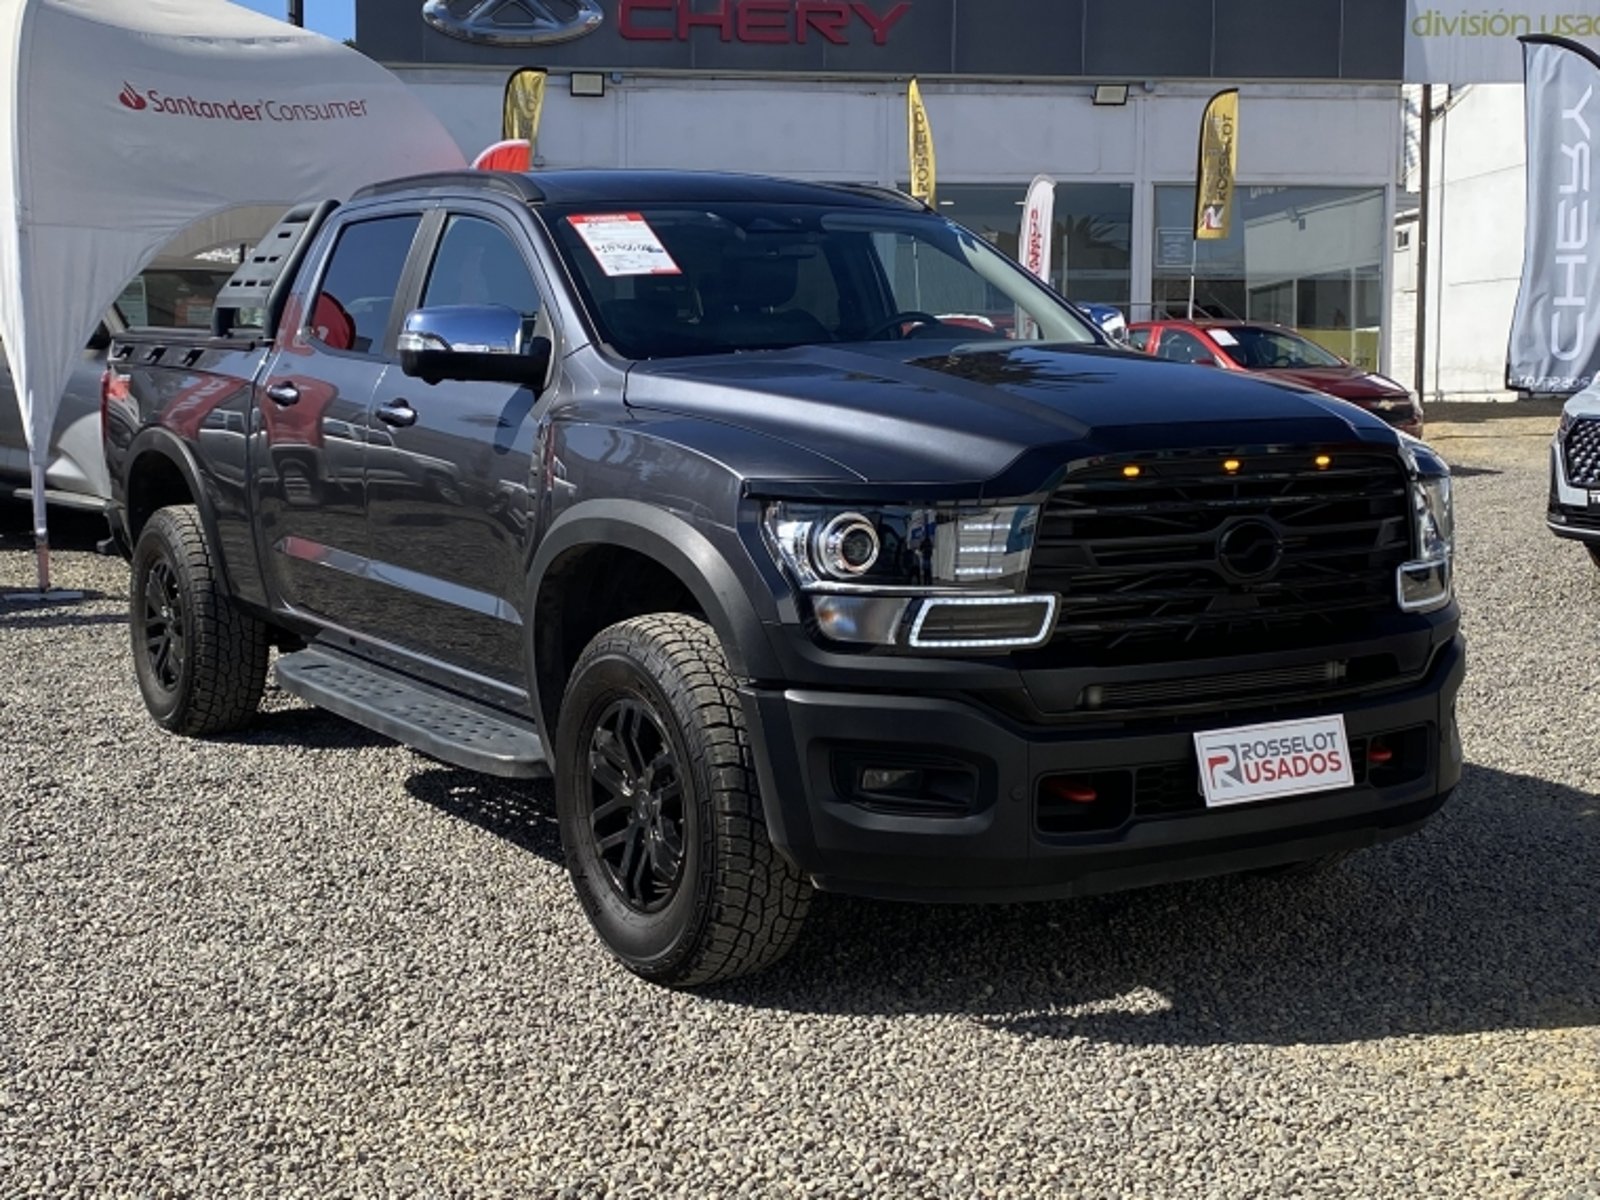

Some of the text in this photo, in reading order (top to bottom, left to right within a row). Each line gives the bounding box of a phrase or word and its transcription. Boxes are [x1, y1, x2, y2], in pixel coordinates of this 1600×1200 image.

[618, 0, 910, 45] CHERY
[1411, 8, 1531, 38] división
[147, 90, 368, 122] Santander Consumer
[1239, 731, 1338, 761] ROSSELOT
[1244, 750, 1343, 784] USADOS
